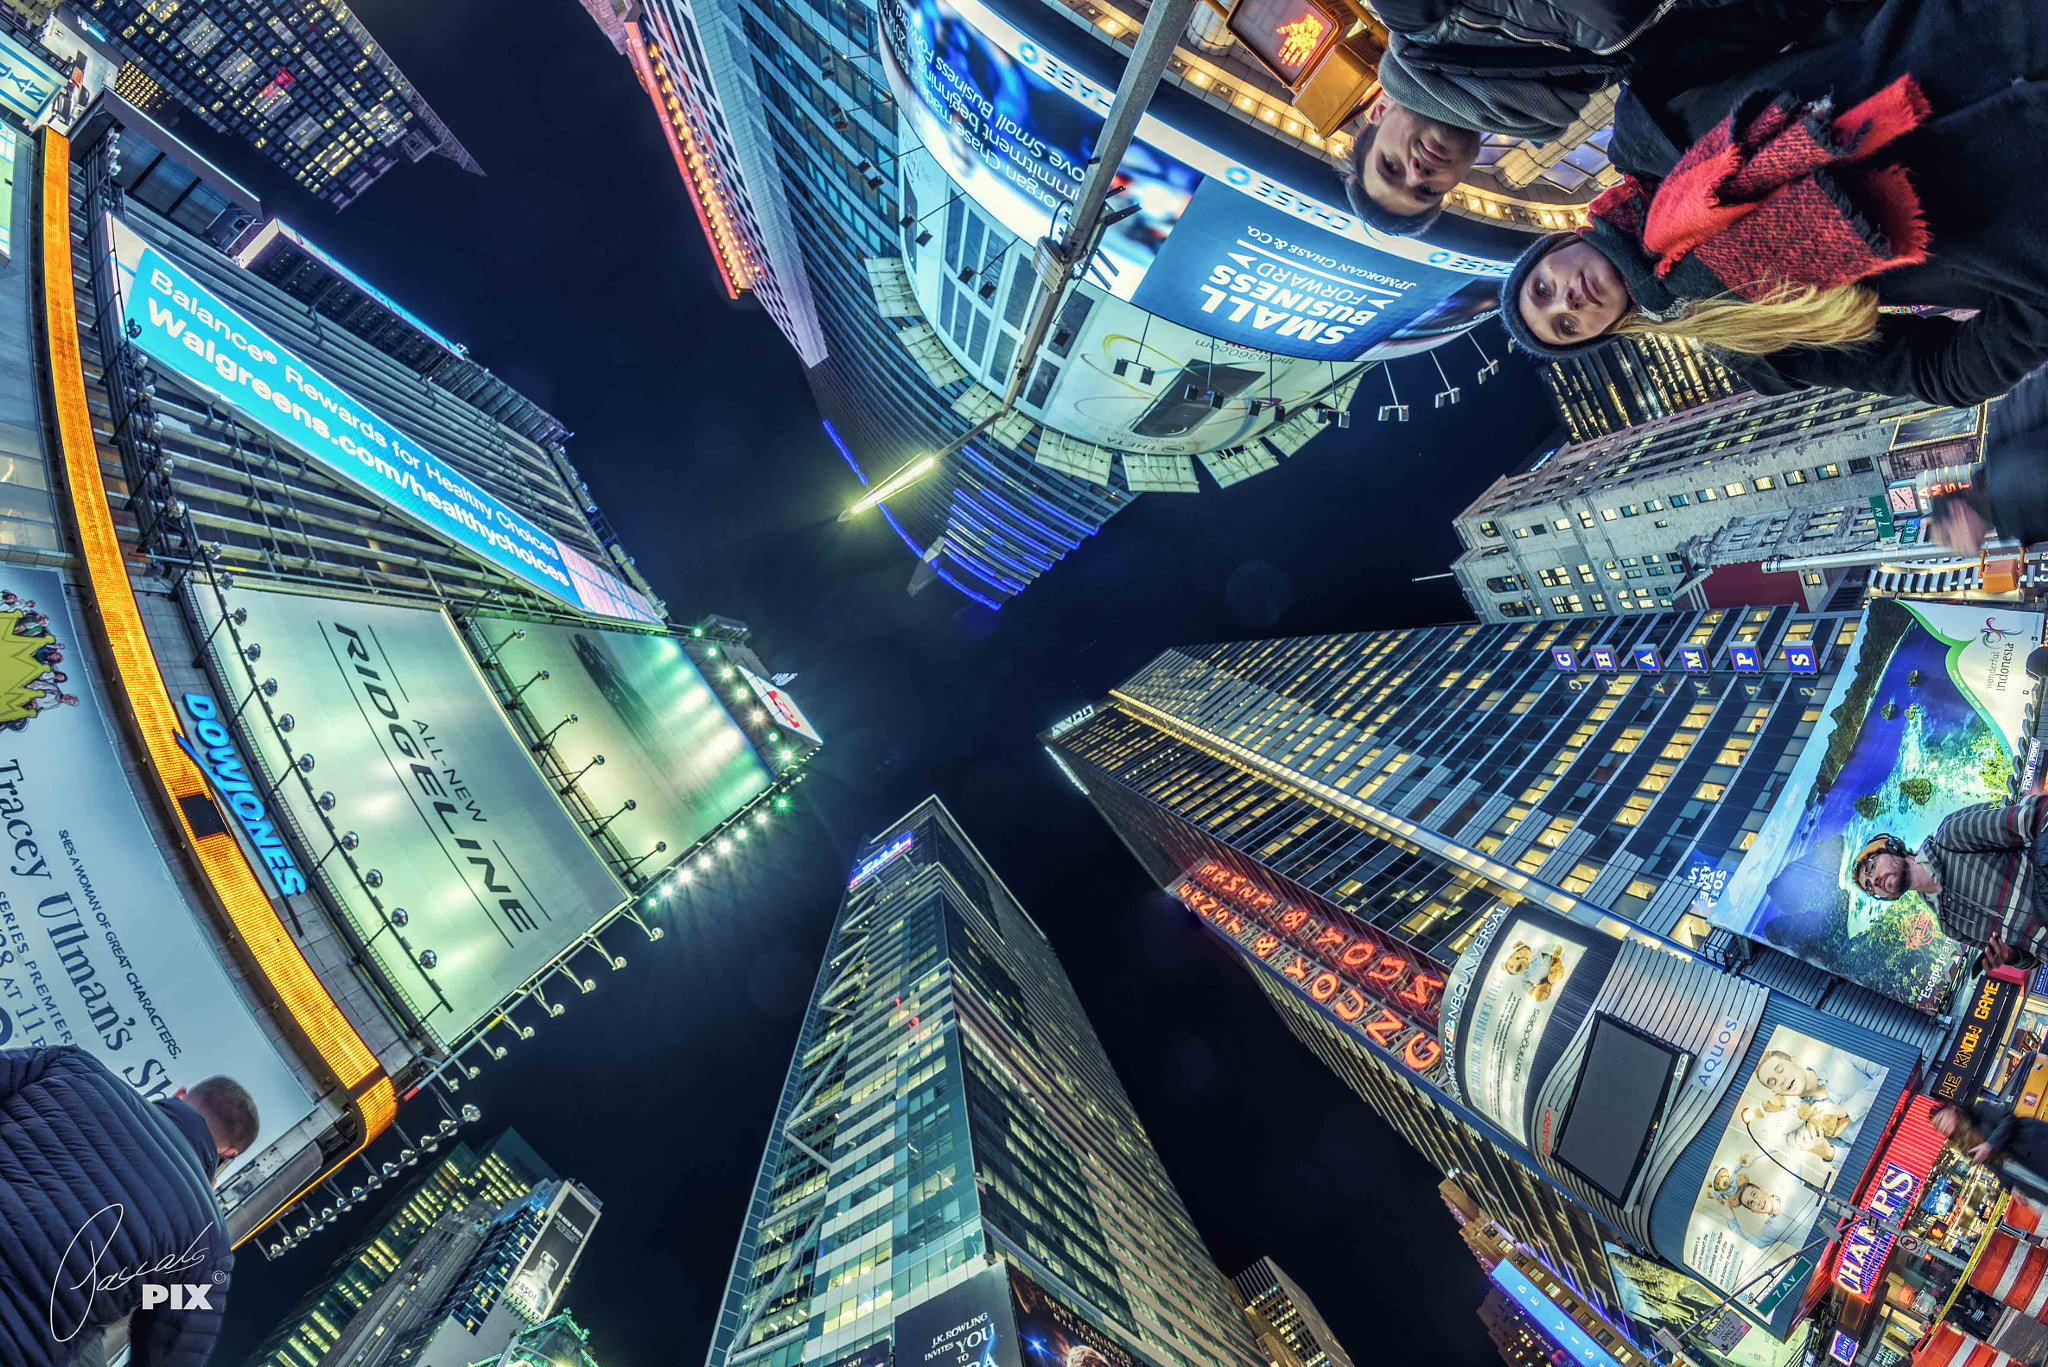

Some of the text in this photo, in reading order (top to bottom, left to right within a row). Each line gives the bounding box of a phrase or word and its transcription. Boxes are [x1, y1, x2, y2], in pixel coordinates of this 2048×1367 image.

[917, 53, 979, 132] beginning
[920, 80, 953, 125] made
[935, 57, 994, 120] Business
[955, 122, 1001, 170] Chase
[995, 114, 1046, 158] Small
[982, 122, 1079, 201] mmitment
[1049, 151, 1086, 182] ove
[1255, 180, 1352, 231] CHASE
[1246, 225, 1417, 291] JPMORGAN CHASE & CO.
[1208, 264, 1378, 326] BUSINESS
[1256, 261, 1368, 305] FORWARD
[1200, 284, 1355, 345] SMALL
[1194, 338, 1296, 366] theta360.com
[147, 296, 570, 587] Walgreens.com/healthychoices
[285, 364, 388, 448] Rewards
[391, 440, 421, 470] for
[425, 462, 492, 520] Healthy
[495, 511, 560, 561] Choices
[1556, 651, 1810, 669] CHAMPS
[1986, 651, 2000, 689] wonderful
[1996, 642, 2014, 691] indonesia
[334, 621, 540, 933] RIDGELINE
[412, 719, 488, 823] ALL-NEW
[2022, 738, 2039, 791] FRONT/PRIME
[70, 856, 82, 869] A
[74, 864, 101, 911] WOMAN
[0, 759, 173, 1100] Tracey Ullman's Sh
[96, 911, 112, 931] OF
[0, 891, 78, 1047] SERIES PREMIER
[105, 931, 133, 971] GREAT
[1447, 905, 1510, 1021] NBCUNIVERSAL
[1937, 953, 1947, 968] to
[1943, 944, 1951, 954] a
[0, 976, 23, 1000] AT
[1178, 882, 1442, 1071] ERNST & YOUNG
[126, 972, 182, 1060] CHARACTERS.
[1938, 979, 2001, 1099] WE KNOW GAME
[1698, 1019, 1738, 1087] AQUOS
[1542, 1109, 1551, 1155] SHARP
[1772, 1289, 1782, 1299] 7
[924, 1342, 954, 1361] INVITES
[954, 1322, 997, 1354] YOU
[948, 1312, 989, 1340] ROWLING
[1711, 1315, 1731, 1338] BUSES
[1720, 1325, 1736, 1341] ONLY
[956, 1352, 970, 1363] TO
